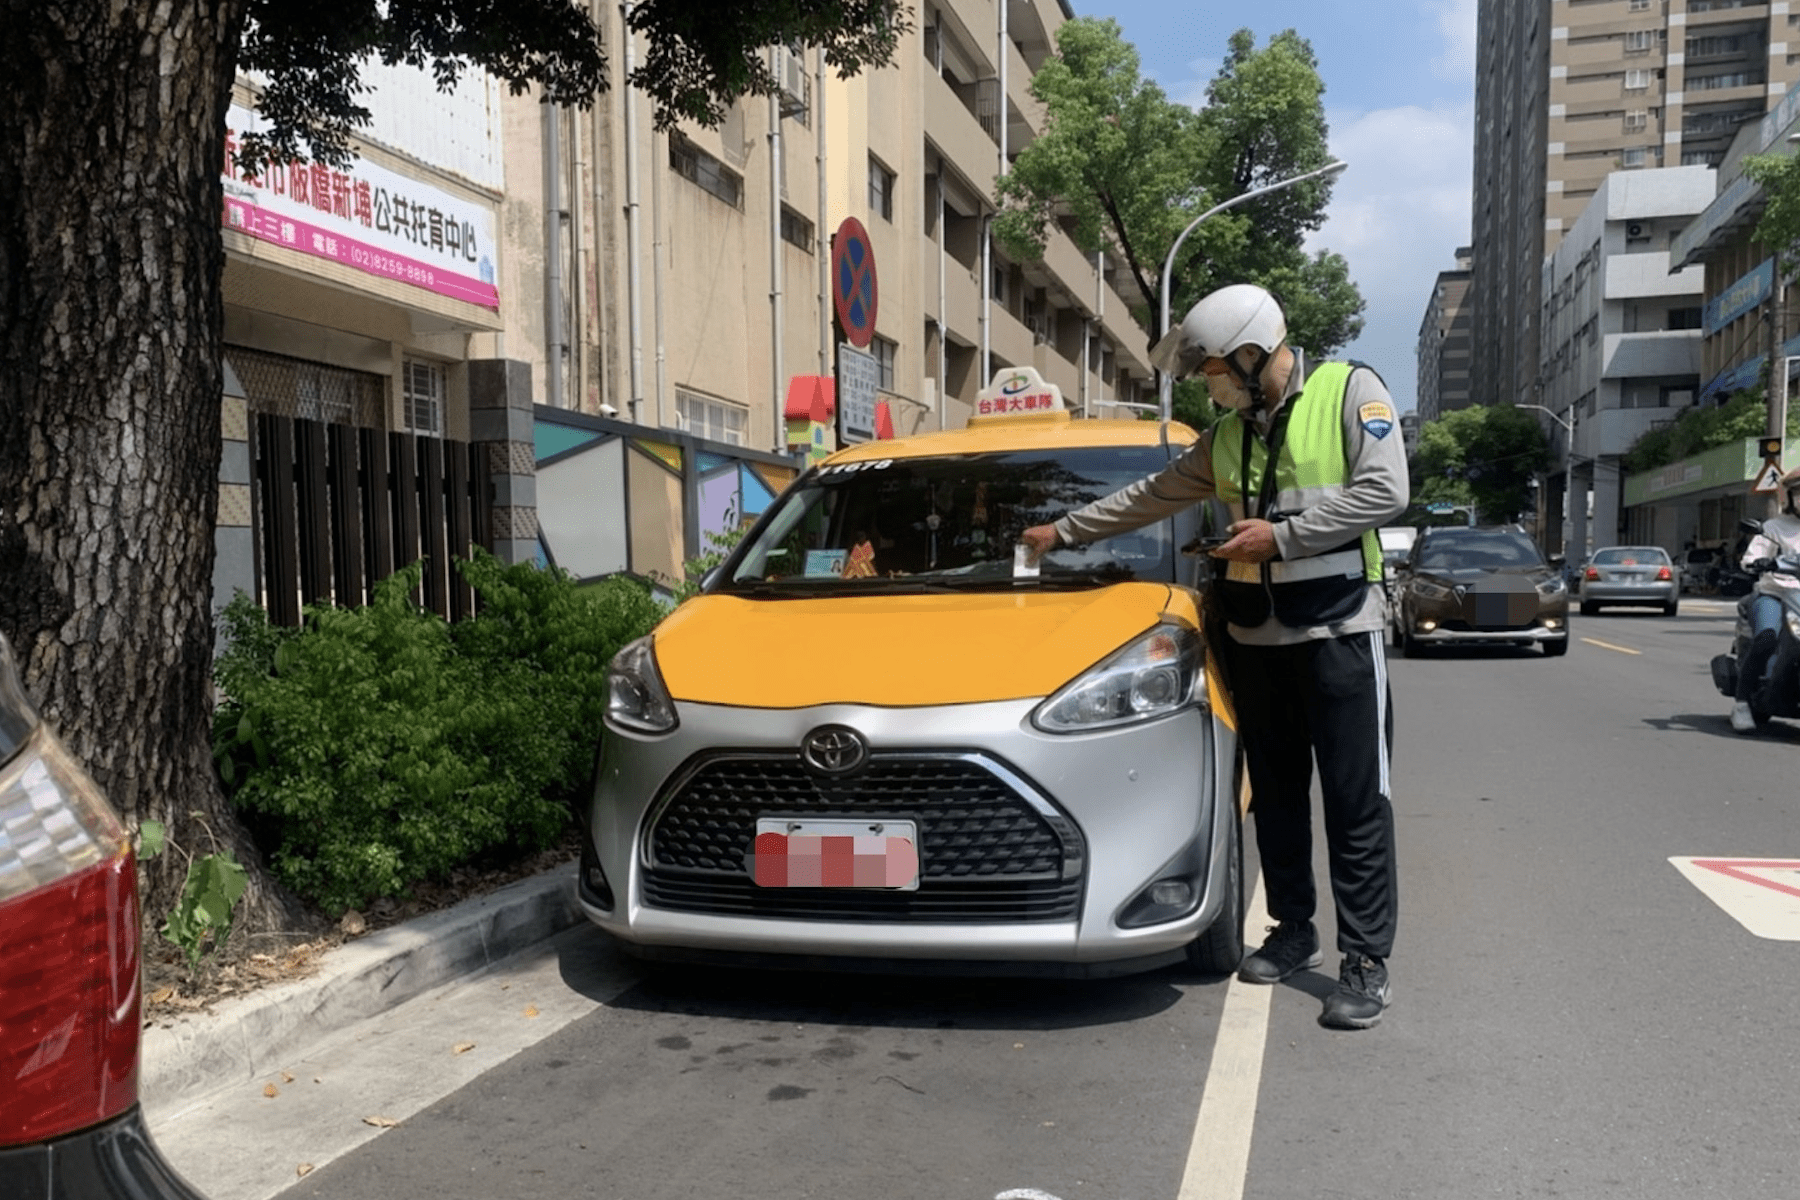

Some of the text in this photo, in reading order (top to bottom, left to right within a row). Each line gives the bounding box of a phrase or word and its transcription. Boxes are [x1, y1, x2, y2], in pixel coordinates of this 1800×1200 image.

[978, 393, 1053, 414] 台灣大車隊
